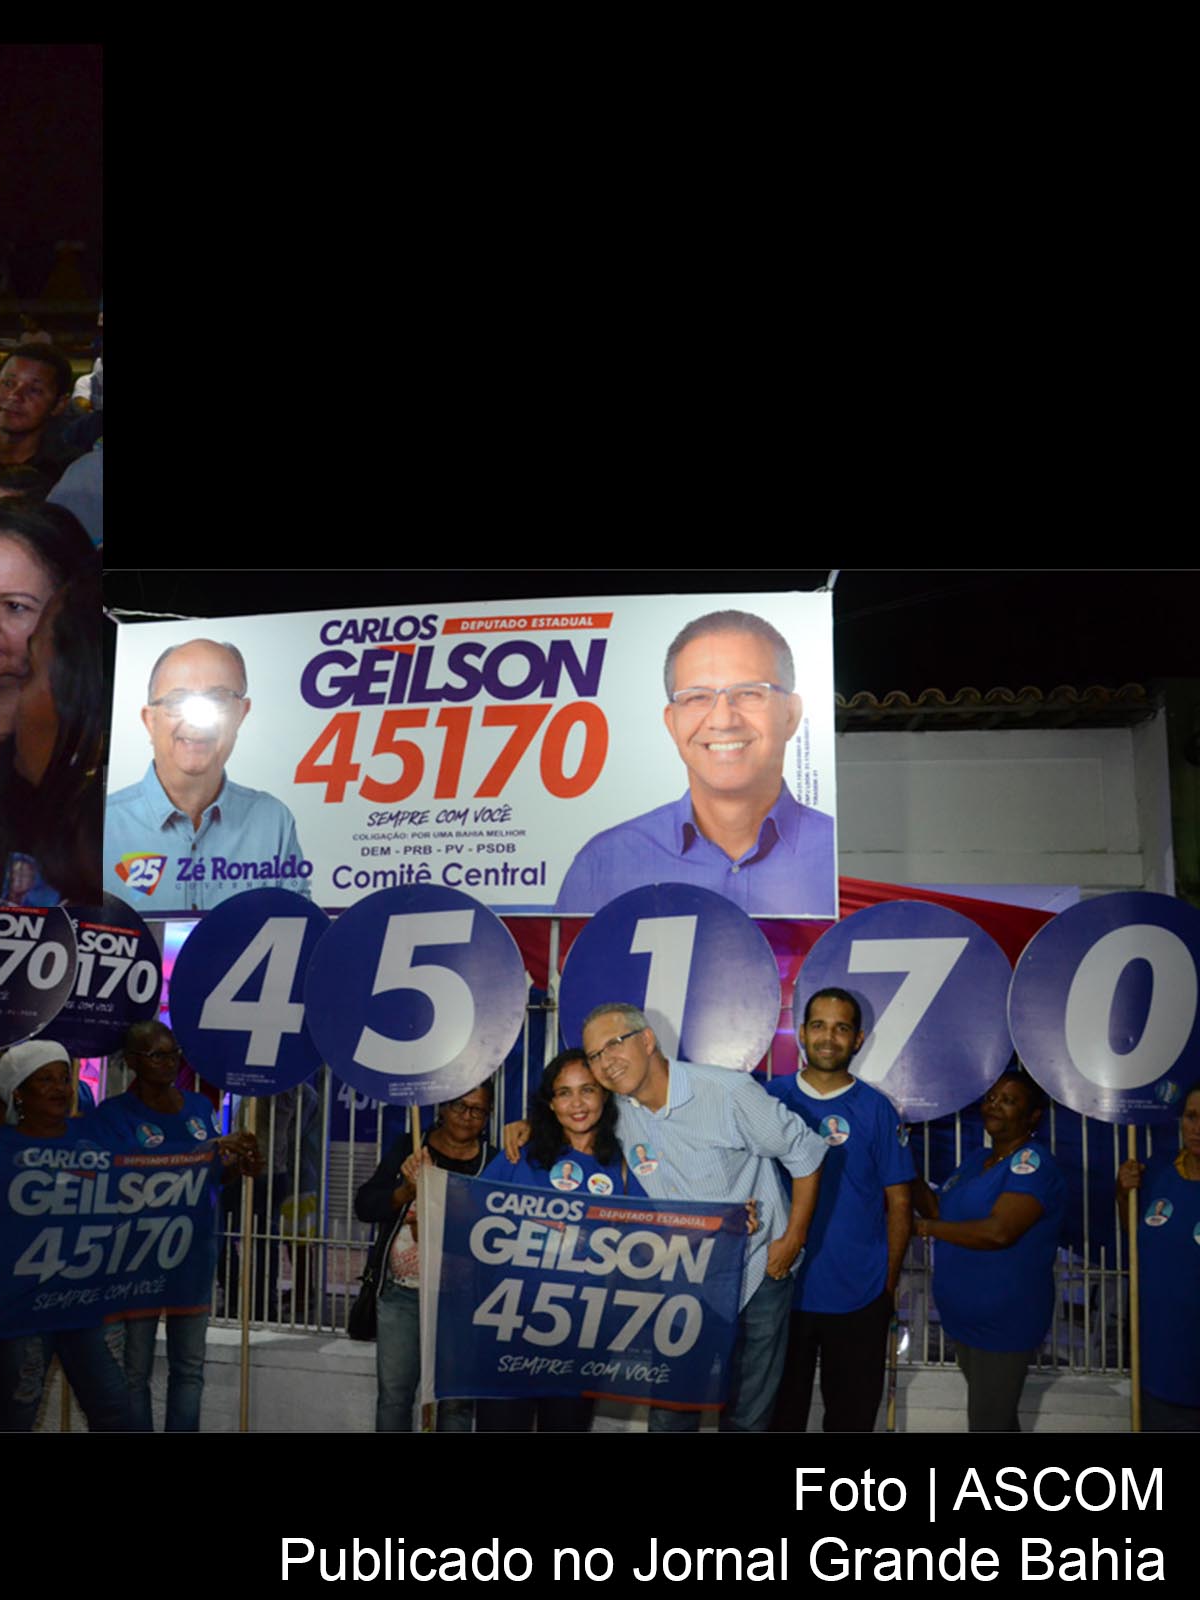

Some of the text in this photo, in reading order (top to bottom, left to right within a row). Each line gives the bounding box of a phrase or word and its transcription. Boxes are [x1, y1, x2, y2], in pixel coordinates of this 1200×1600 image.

[320, 614, 438, 646] CARLOS
[461, 615, 593, 630] DEPUTADO ESTADUAL
[300, 638, 608, 709] GEILSON
[294, 701, 609, 804] 45170
[367, 803, 513, 828] SEMPRE COM VOCÊ
[360, 845, 392, 857] DEM
[403, 844, 433, 856] PRB
[445, 844, 465, 855] PV
[476, 843, 517, 854] PSDB
[486, 829, 527, 838] MELHOR
[126, 854, 314, 887] 25 Zé Ronaldo
[332, 861, 547, 890] Comitê Central
[79, 930, 139, 958] SON
[199, 917, 307, 1067] 4
[352, 909, 475, 1075] 5
[629, 915, 698, 1063] 1
[848, 937, 970, 1083] 7
[1065, 923, 1198, 1090] 0
[22, 1147, 110, 1170] CARLOS
[8, 1167, 208, 1216] GEILSON
[486, 1192, 584, 1221] CARLOS
[599, 1211, 706, 1227] DEPUTADO ESTADUAL
[13, 1215, 193, 1284] 45170
[469, 1216, 715, 1284] GEILSON
[472, 1278, 703, 1357] 45170
[498, 1355, 672, 1384] SEMPRE COM VOCÊ
